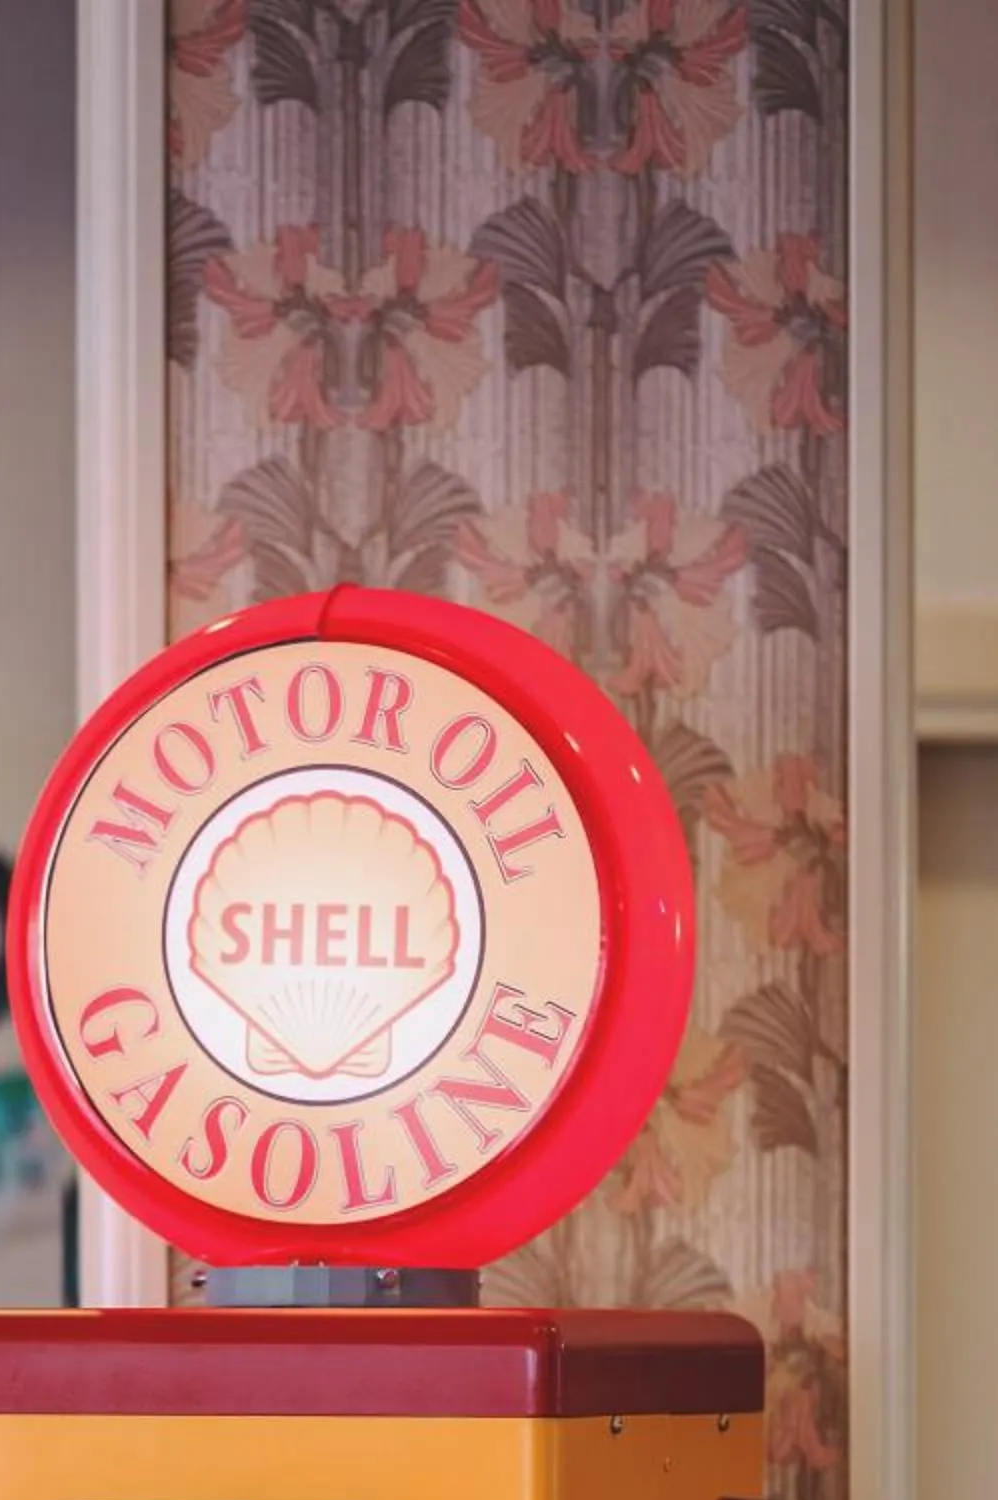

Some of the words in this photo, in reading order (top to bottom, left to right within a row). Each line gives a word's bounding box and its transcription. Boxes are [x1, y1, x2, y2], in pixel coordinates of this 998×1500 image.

[87, 661, 415, 880] MOTOR
[430, 712, 568, 884] OIL
[218, 902, 426, 970] SHELL
[79, 981, 577, 1212] GASOLINE
